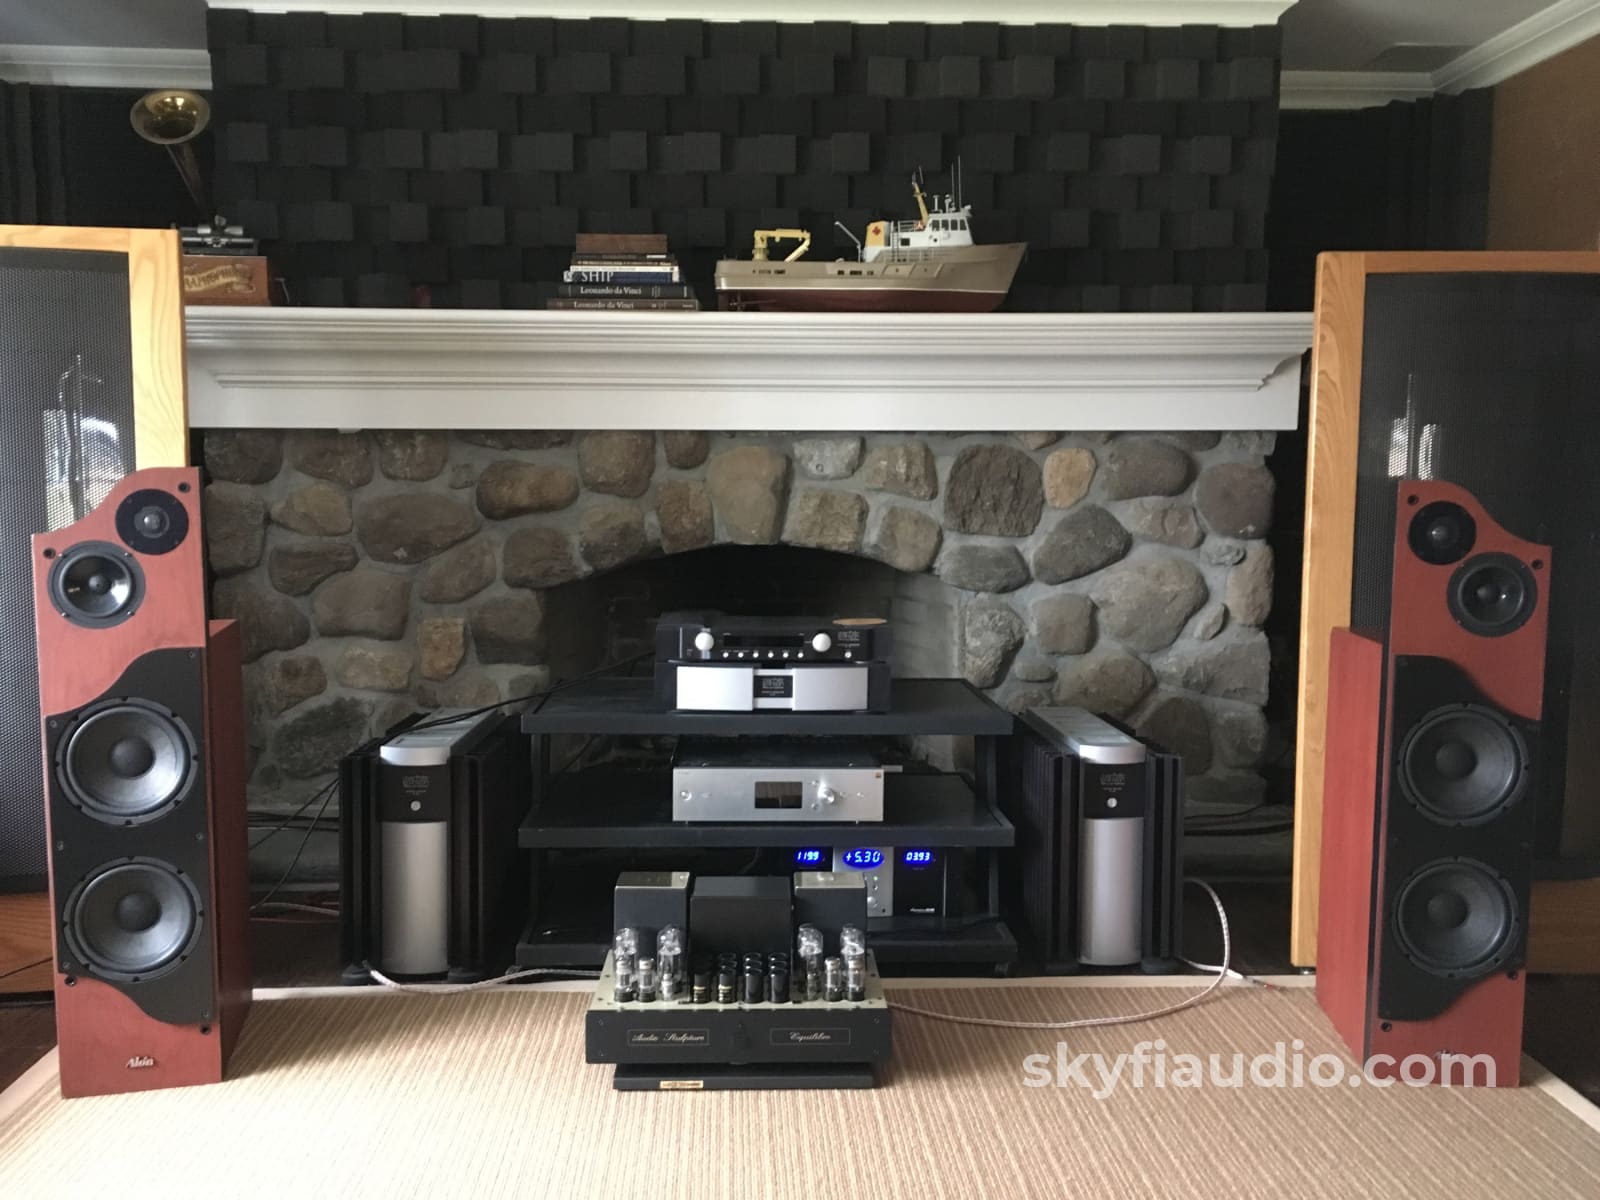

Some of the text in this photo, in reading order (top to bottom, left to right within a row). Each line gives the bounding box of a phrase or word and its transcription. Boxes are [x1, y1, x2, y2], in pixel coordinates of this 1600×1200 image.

[581, 270, 615, 282] SHIP
[580, 286, 642, 295] Leonardo da Vinci
[574, 301, 605, 309] Leonardo
